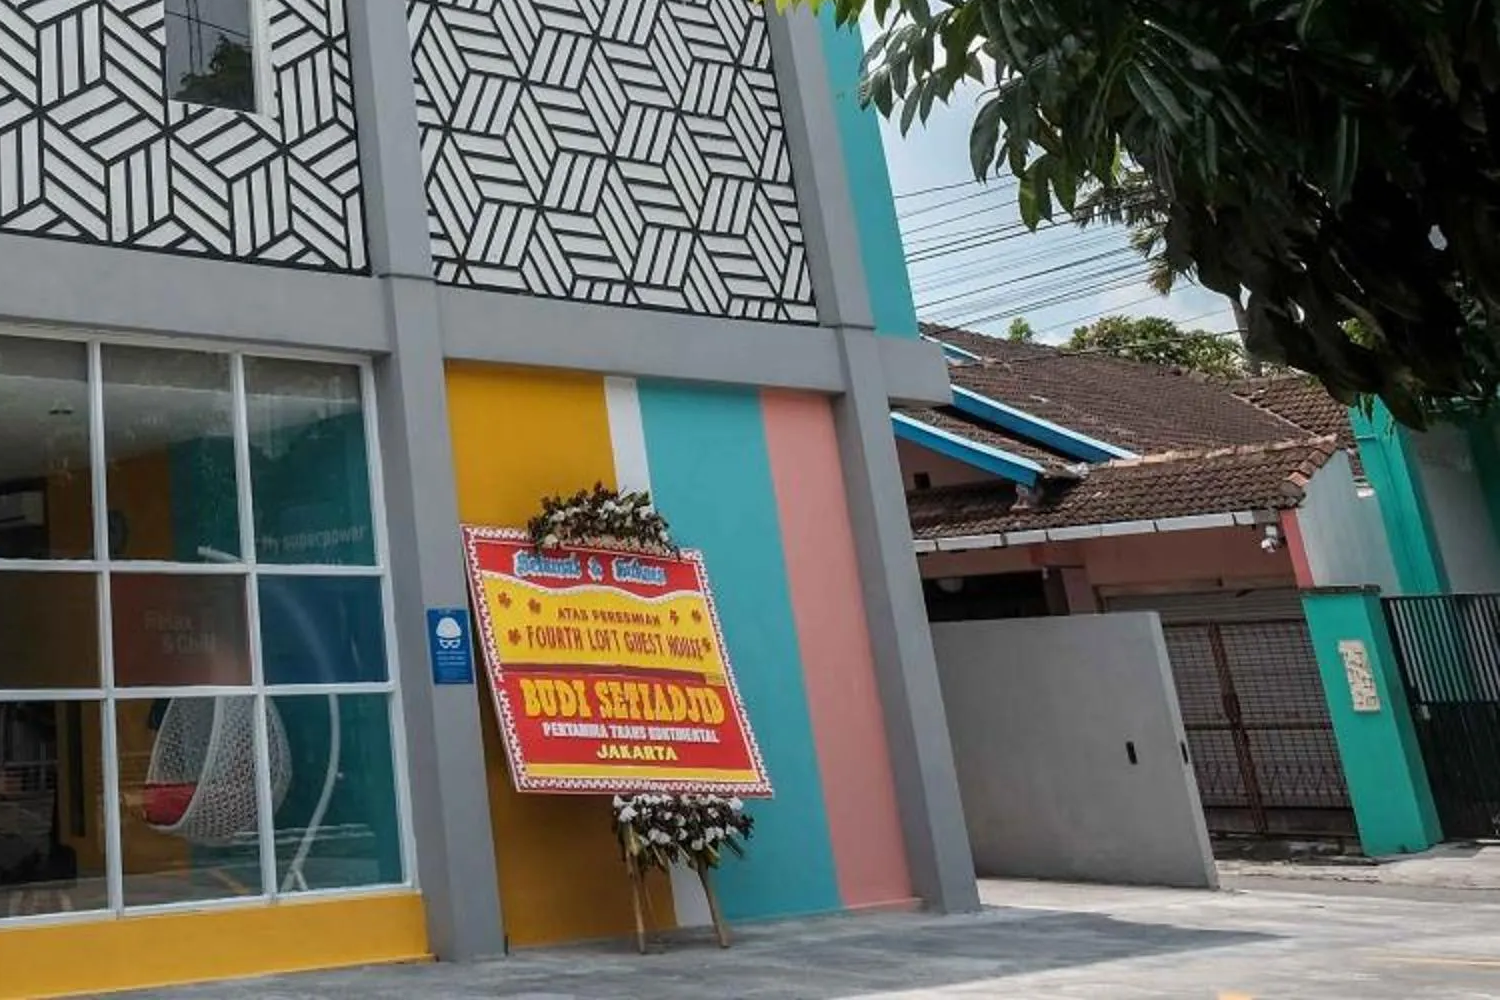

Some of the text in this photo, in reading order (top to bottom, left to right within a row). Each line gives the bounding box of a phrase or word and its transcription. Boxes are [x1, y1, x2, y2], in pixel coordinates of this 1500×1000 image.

[557, 607, 589, 621] ATAS
[526, 625, 705, 660] FOURTH LOFT GUEST HOUSE
[519, 678, 593, 717] BUDI
[596, 744, 678, 761] JAKARTA
